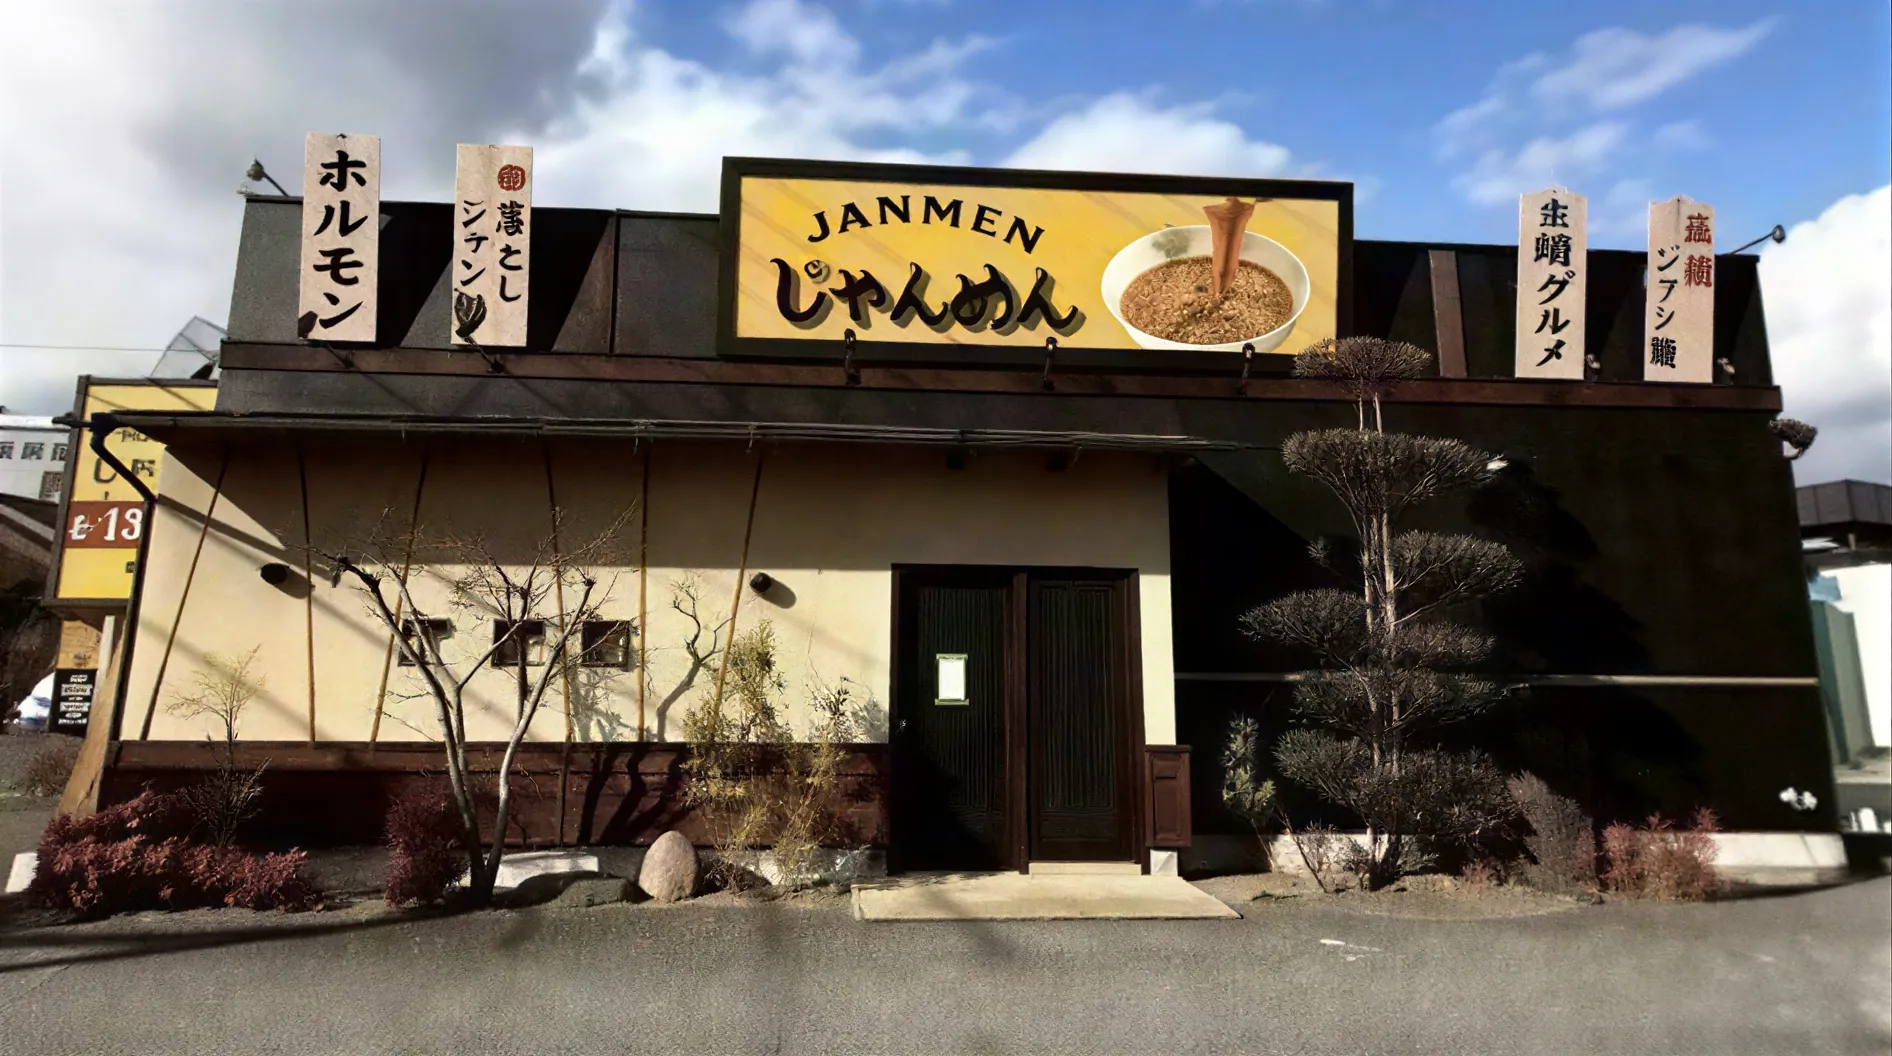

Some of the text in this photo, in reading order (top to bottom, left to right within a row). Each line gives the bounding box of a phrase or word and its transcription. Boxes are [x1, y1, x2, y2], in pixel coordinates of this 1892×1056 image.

[313, 150, 368, 329] ホルモン
[808, 194, 1045, 254] JANMEN
[769, 257, 1082, 333] じゃんめん
